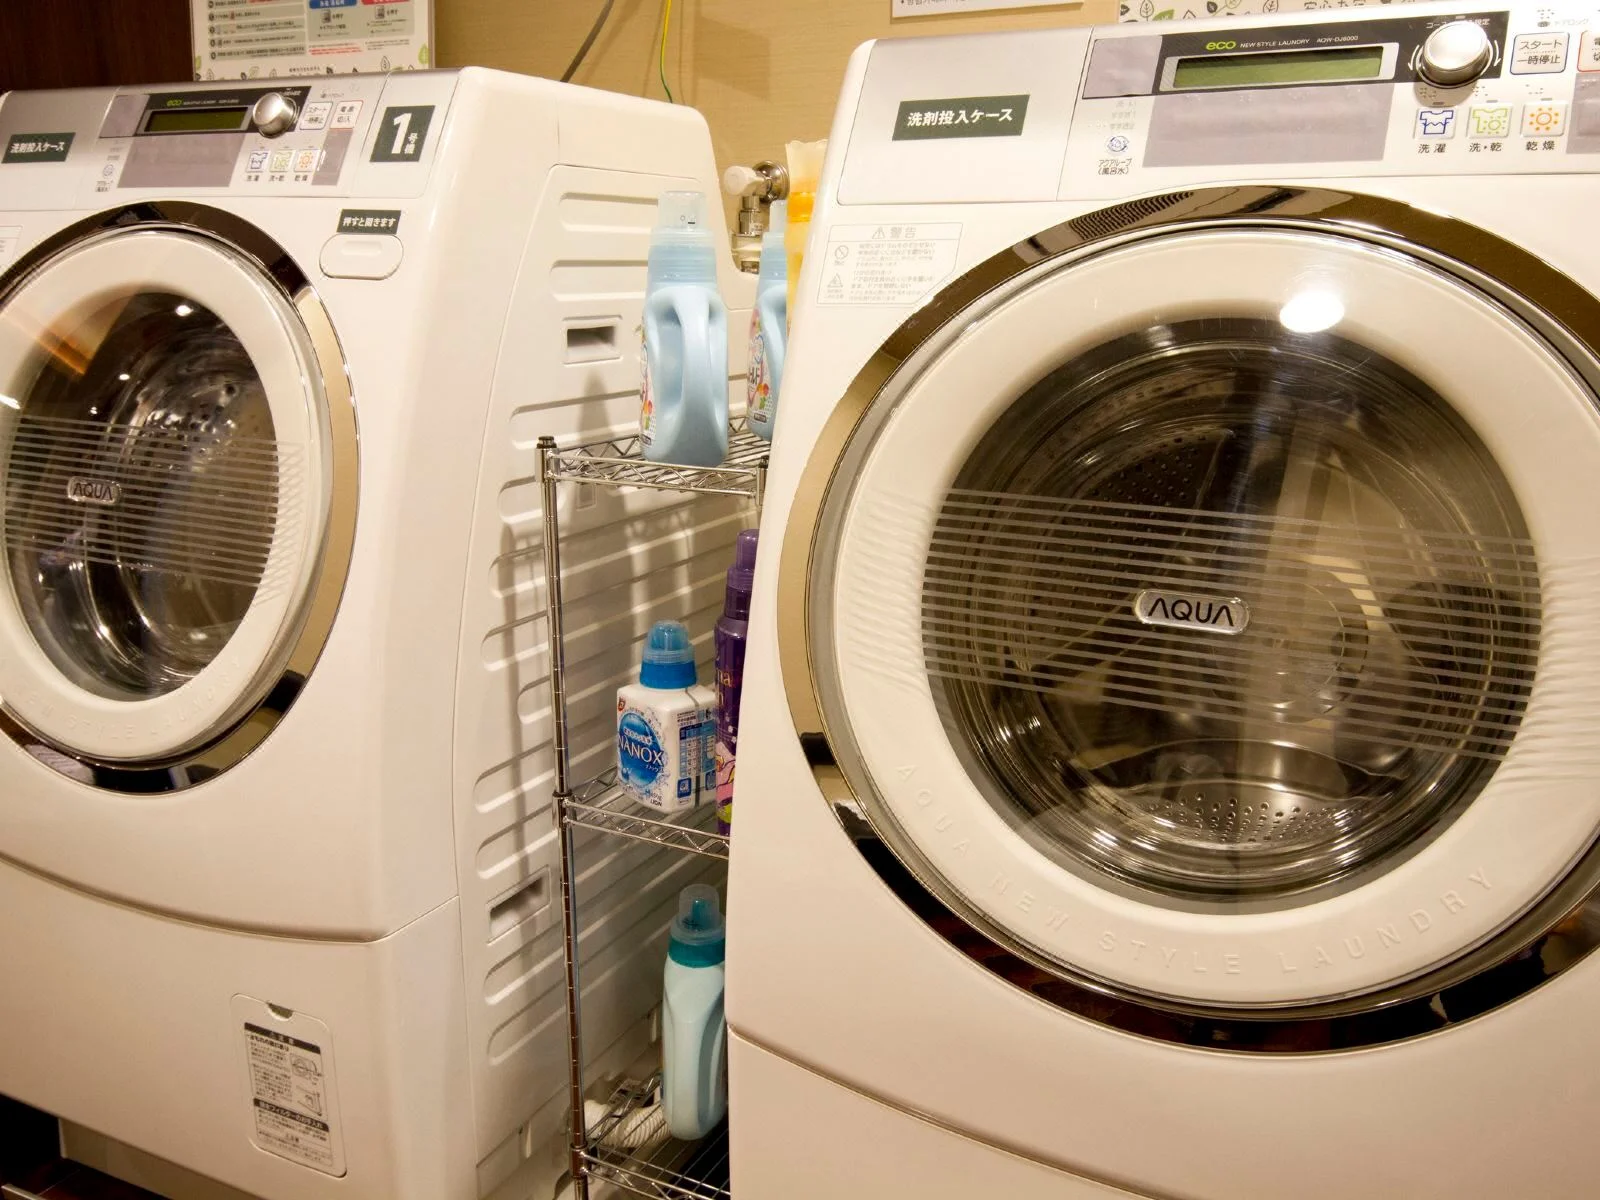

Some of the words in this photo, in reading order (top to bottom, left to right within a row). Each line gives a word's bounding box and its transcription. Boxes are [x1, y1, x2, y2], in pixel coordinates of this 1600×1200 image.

[1205, 40, 1237, 51] eco
[1256, 40, 1277, 48] STYLE
[1278, 38, 1311, 47] LAUNDRY
[1519, 39, 1563, 50] スタート
[1516, 53, 1561, 65] 一時停止
[906, 107, 1013, 127] 洗剤投入ケース
[393, 112, 413, 154] 1
[10, 141, 65, 154] 洗剤投入ケース
[1418, 143, 1446, 154] 洗濯
[1525, 139, 1555, 151] 乾燥
[342, 216, 397, 228] 押すと開きます
[73, 482, 113, 501] AQUA
[1147, 597, 1235, 628] AQUA
[618, 735, 664, 768] NANOX
[987, 872, 1070, 933] NEW
[1097, 929, 1242, 976] STYLE
[1279, 867, 1494, 975] LAUNDRY
